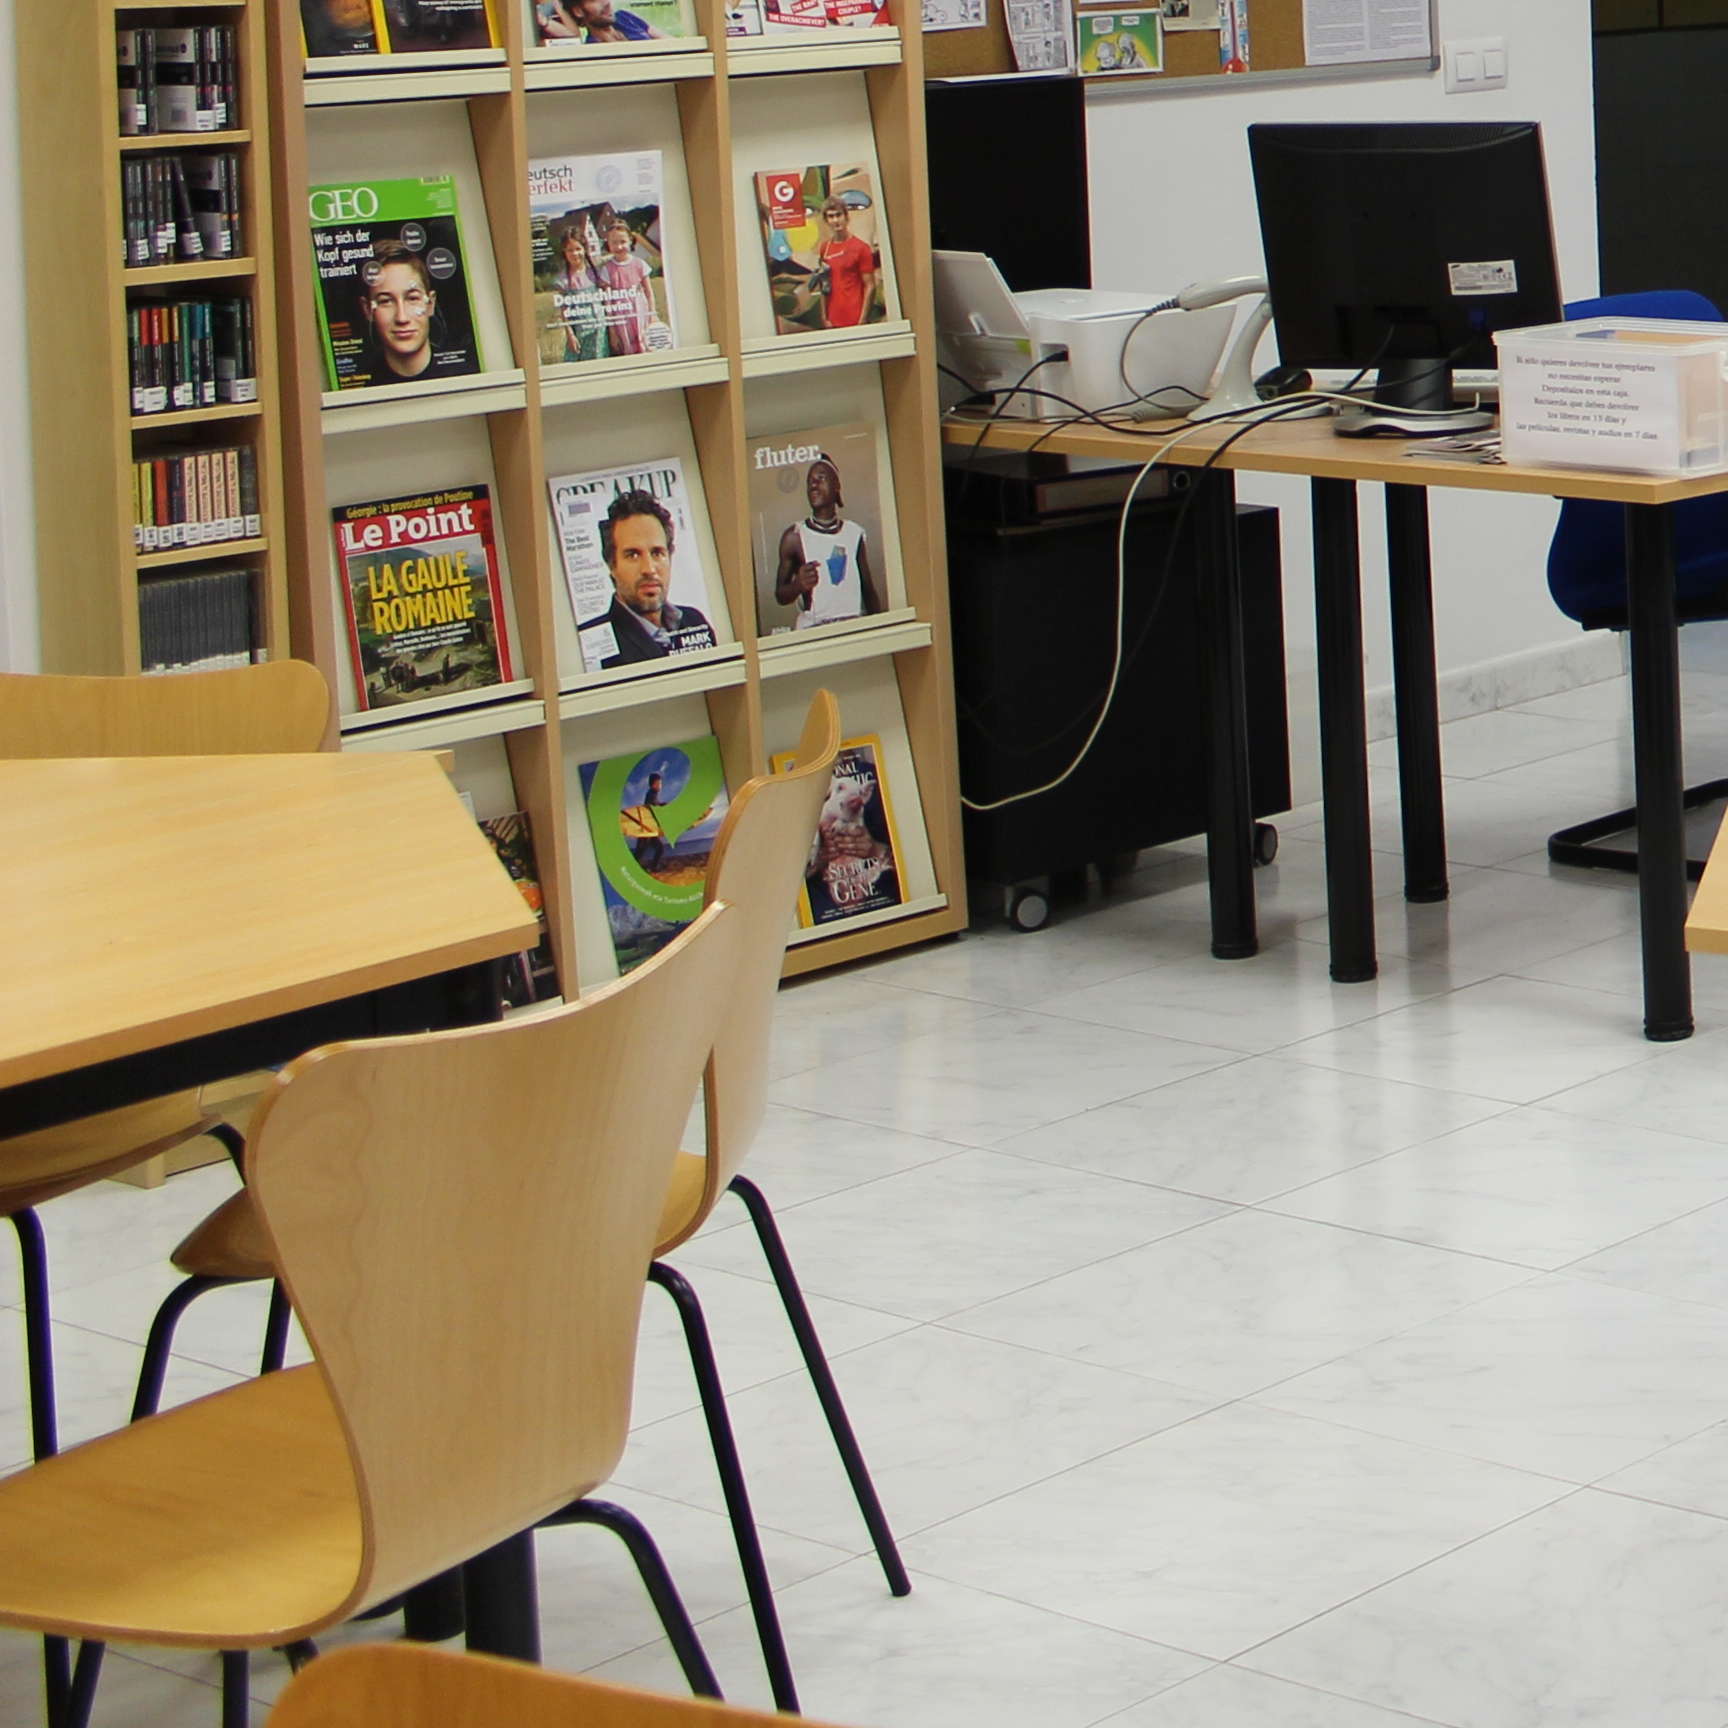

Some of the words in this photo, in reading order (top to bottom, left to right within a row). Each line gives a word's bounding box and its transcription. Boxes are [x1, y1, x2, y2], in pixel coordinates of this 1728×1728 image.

[528, 165, 573, 181] eutsch
[529, 179, 574, 196] erfekt
[309, 187, 379, 221] GEO
[314, 233, 333, 247] Wie
[335, 231, 354, 244] sich
[356, 230, 371, 243] der
[317, 248, 340, 265] Kopf
[342, 244, 375, 262] gesund
[320, 264, 358, 279] trainiert
[553, 284, 641, 308] Deutschland,
[564, 303, 591, 318] deine
[1540, 358, 1567, 368] quieres
[1568, 359, 1599, 369] devolver
[1615, 362, 1655, 372] ejemplares
[1559, 373, 1591, 381] necesitas
[1596, 388, 1611, 396] esta
[1534, 397, 1567, 406] Recuerda
[1569, 400, 1583, 409] que
[1585, 400, 1605, 409] debes
[1607, 402, 1640, 411] devolver
[1547, 411, 1558, 419] los
[1560, 411, 1580, 420] libros
[755, 444, 822, 470] fluter.
[391, 495, 433, 513] provocation
[434, 494, 444, 505] de
[342, 522, 383, 551] Le
[387, 503, 475, 544] Point
[368, 563, 398, 600] LA
[401, 551, 471, 593] GAULE
[373, 585, 475, 635] ROMAINE
[682, 631, 711, 647] MARK
[833, 879, 877, 903] GENE
